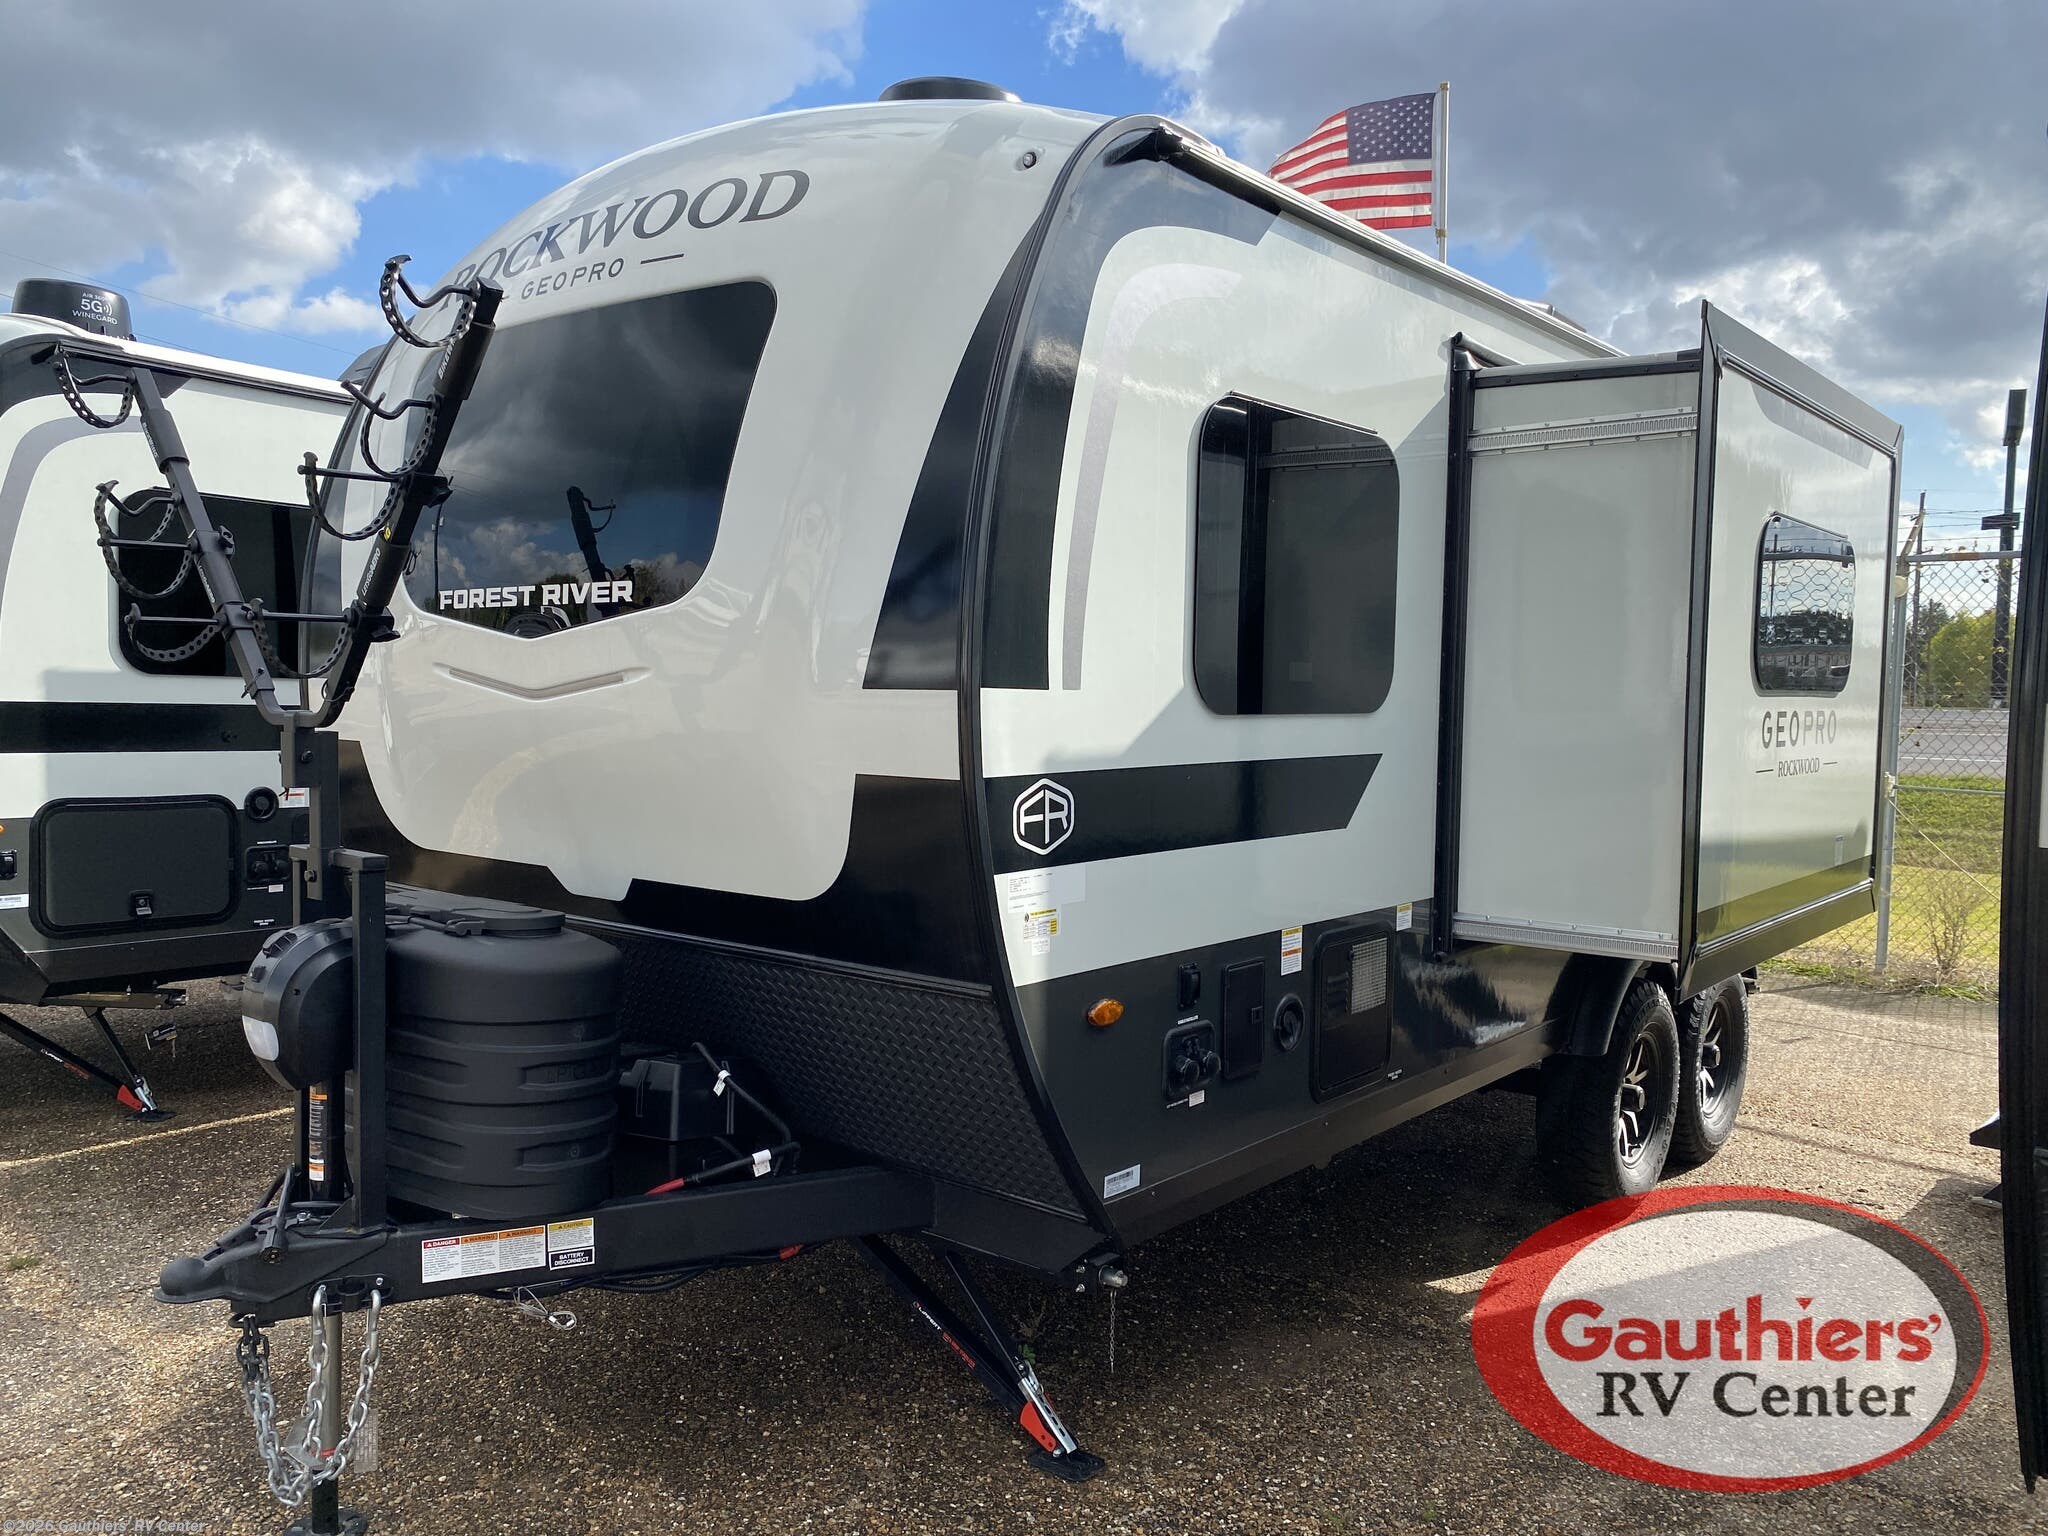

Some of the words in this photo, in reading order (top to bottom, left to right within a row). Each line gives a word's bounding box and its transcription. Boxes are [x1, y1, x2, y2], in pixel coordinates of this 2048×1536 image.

[438, 169, 811, 313] ROCKWOOD
[520, 256, 625, 301] GEOPRO
[80, 298, 103, 314] 5G
[72, 309, 118, 325] WINEGARD
[439, 585, 536, 610] FOREST
[541, 580, 633, 606] RIVER
[1761, 709, 1837, 749] GEOPRO
[1778, 758, 1820, 778] ROCKWOOD
[432, 1239, 457, 1247] DANGER
[554, 1256, 589, 1266] DISCONNECT
[559, 1252, 585, 1260] BATTERY
